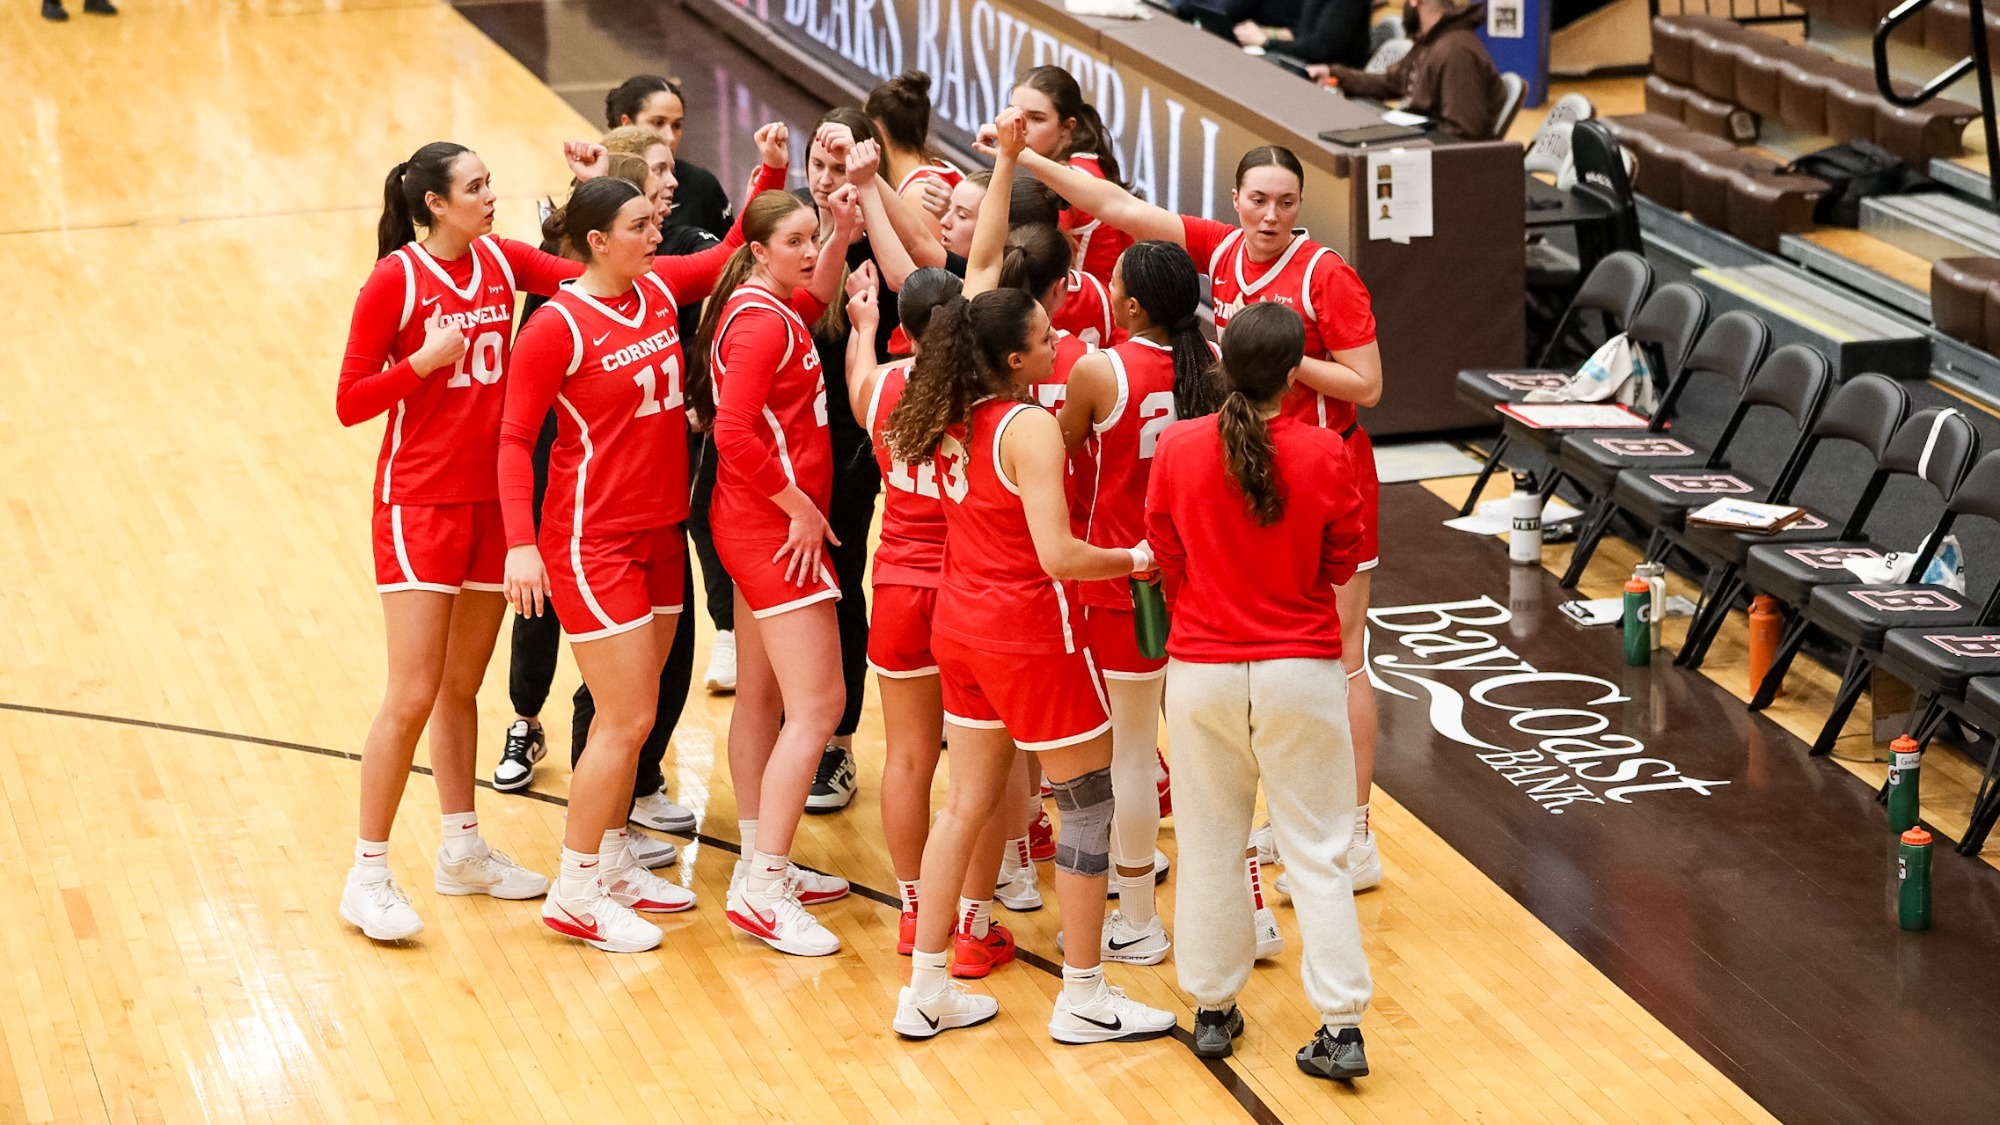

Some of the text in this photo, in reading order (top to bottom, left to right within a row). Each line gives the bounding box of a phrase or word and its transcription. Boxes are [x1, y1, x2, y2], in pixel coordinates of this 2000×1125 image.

[784, 0, 903, 81] ARS
[438, 303, 510, 330] ORNELL
[447, 331, 504, 388] 10
[601, 325, 680, 372] CORNELL
[633, 353, 684, 418] 11
[1513, 517, 1540, 531] YETI
